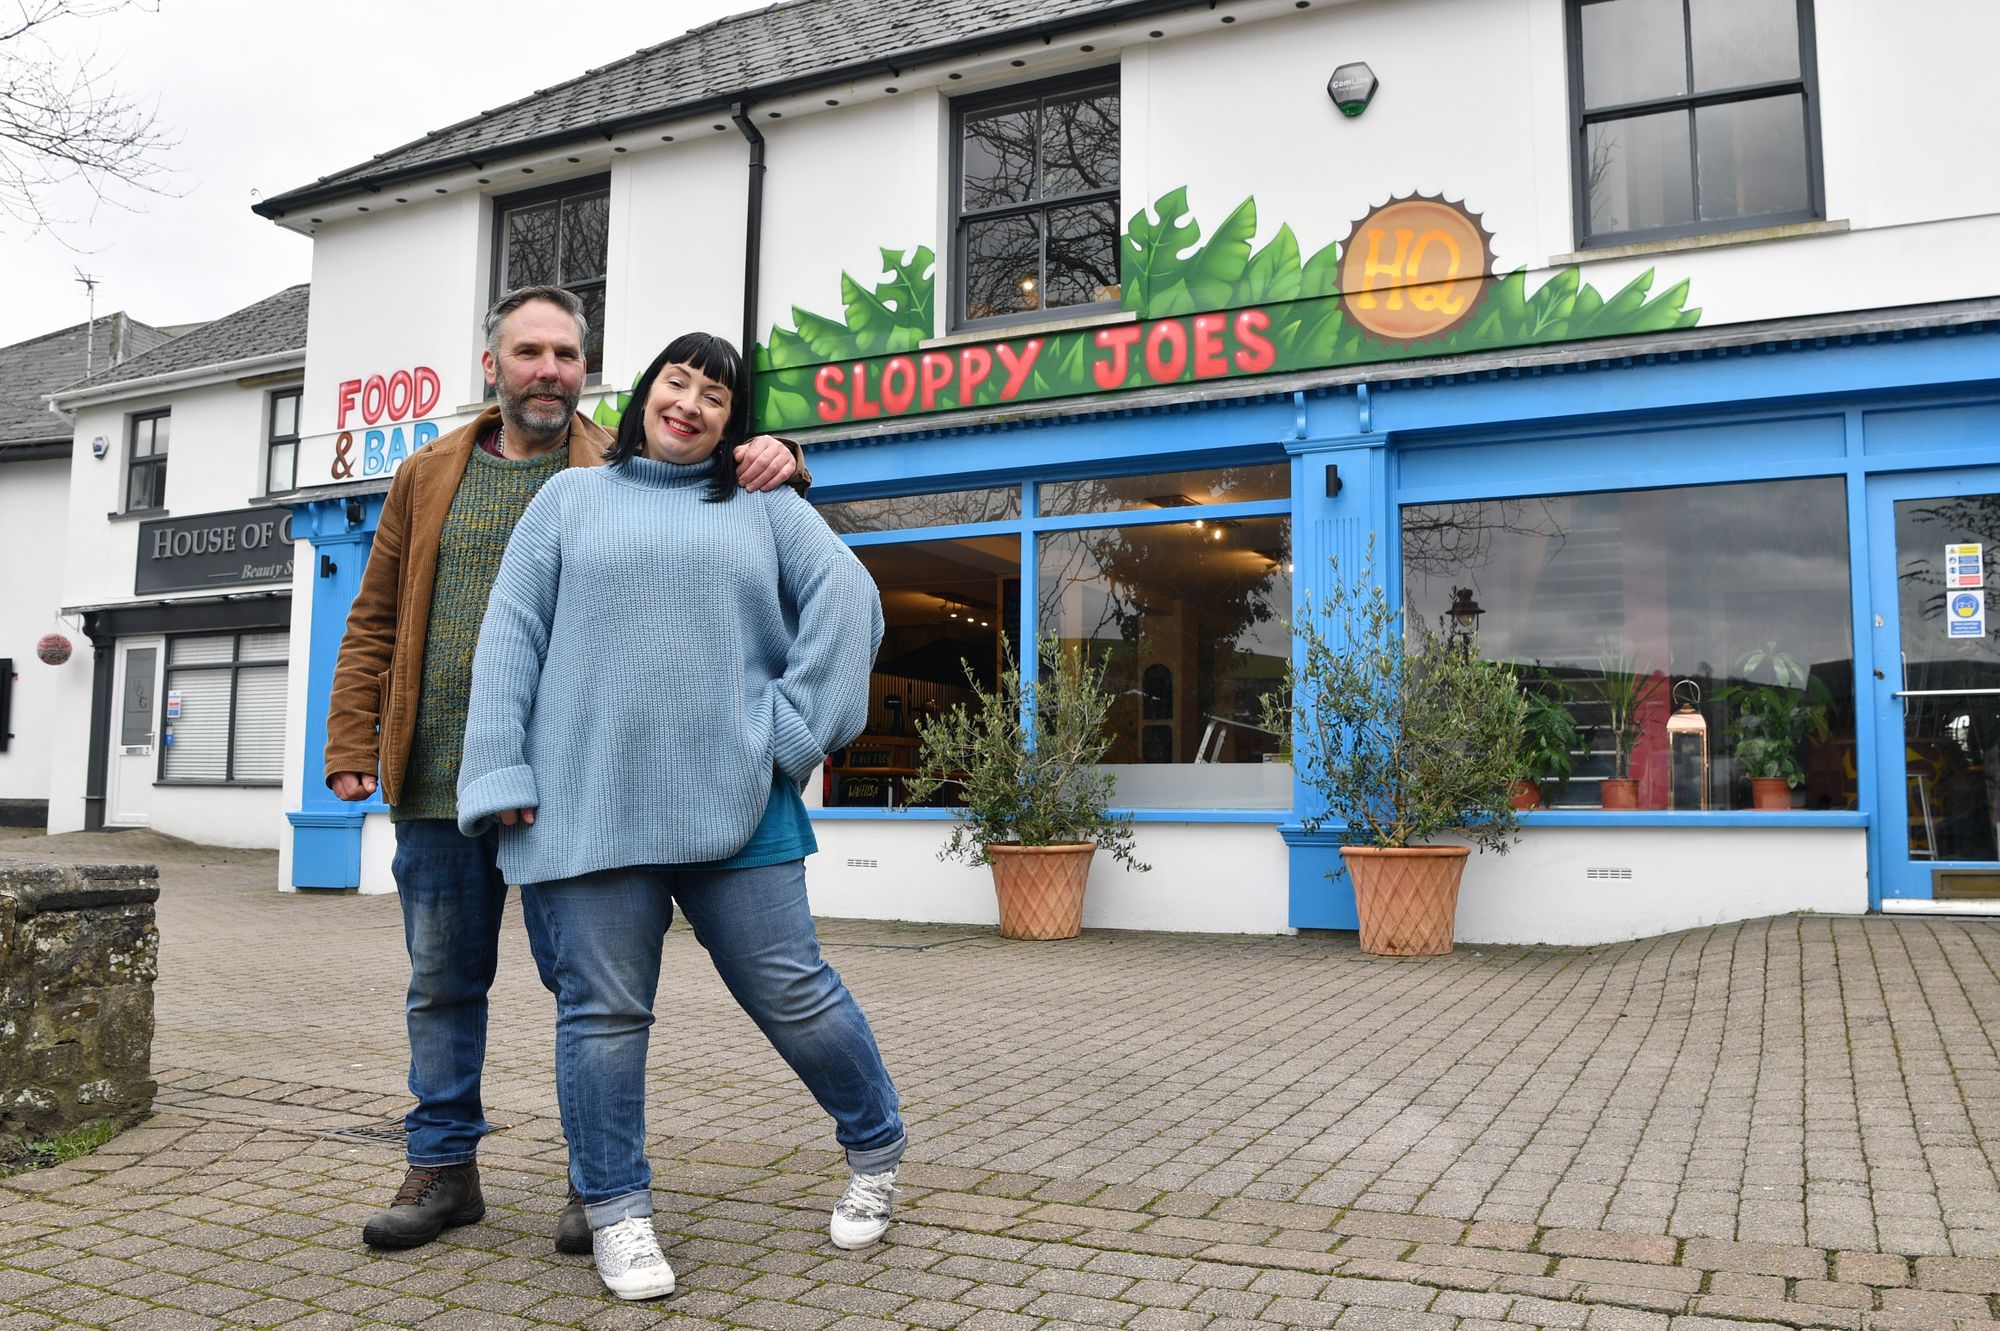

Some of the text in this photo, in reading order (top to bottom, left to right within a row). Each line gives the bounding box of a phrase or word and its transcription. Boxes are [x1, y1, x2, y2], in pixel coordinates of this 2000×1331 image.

[1356, 229, 1465, 315] HQ
[814, 308, 1277, 423] SLOPPY JOES
[337, 366, 440, 430] FOOD
[331, 431, 356, 480] &
[151, 526, 236, 559] HOUSE
[241, 522, 274, 549] OF
[241, 563, 283, 579] Beauty
